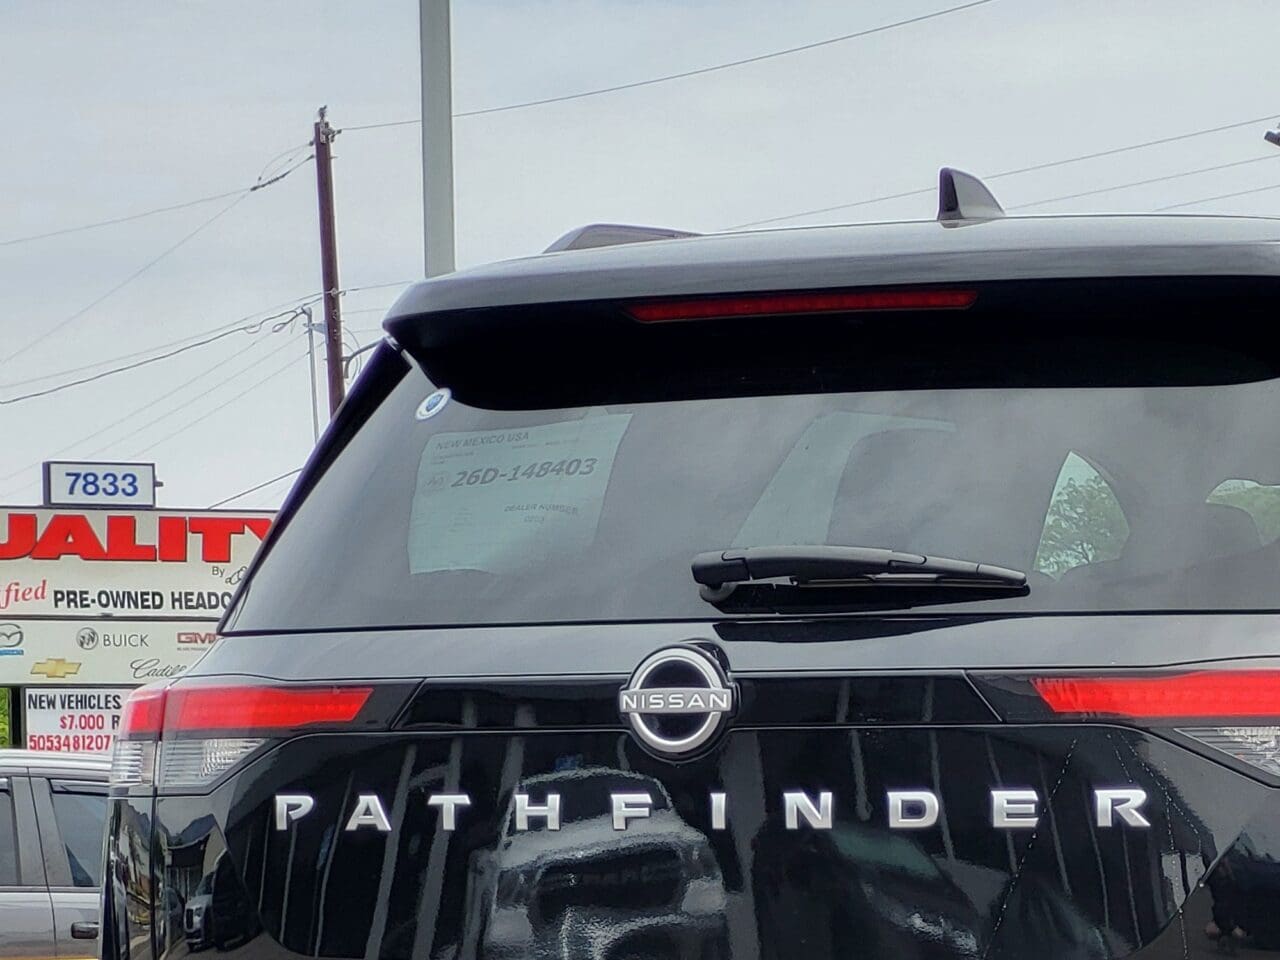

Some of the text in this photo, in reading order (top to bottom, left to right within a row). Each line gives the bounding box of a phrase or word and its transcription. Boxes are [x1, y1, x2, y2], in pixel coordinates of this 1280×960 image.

[506, 432, 530, 442] USA
[450, 456, 599, 489] 26D-148403
[65, 472, 139, 497] 7833
[212, 566, 225, 577] By
[53, 589, 165, 610] PRE-OWNED
[103, 633, 149, 647] BUICK
[28, 693, 122, 710] NEW VEHICLES
[622, 693, 728, 710] NISSAN
[29, 734, 112, 752] 5053481207
[275, 788, 1151, 831] PATHFINDER
